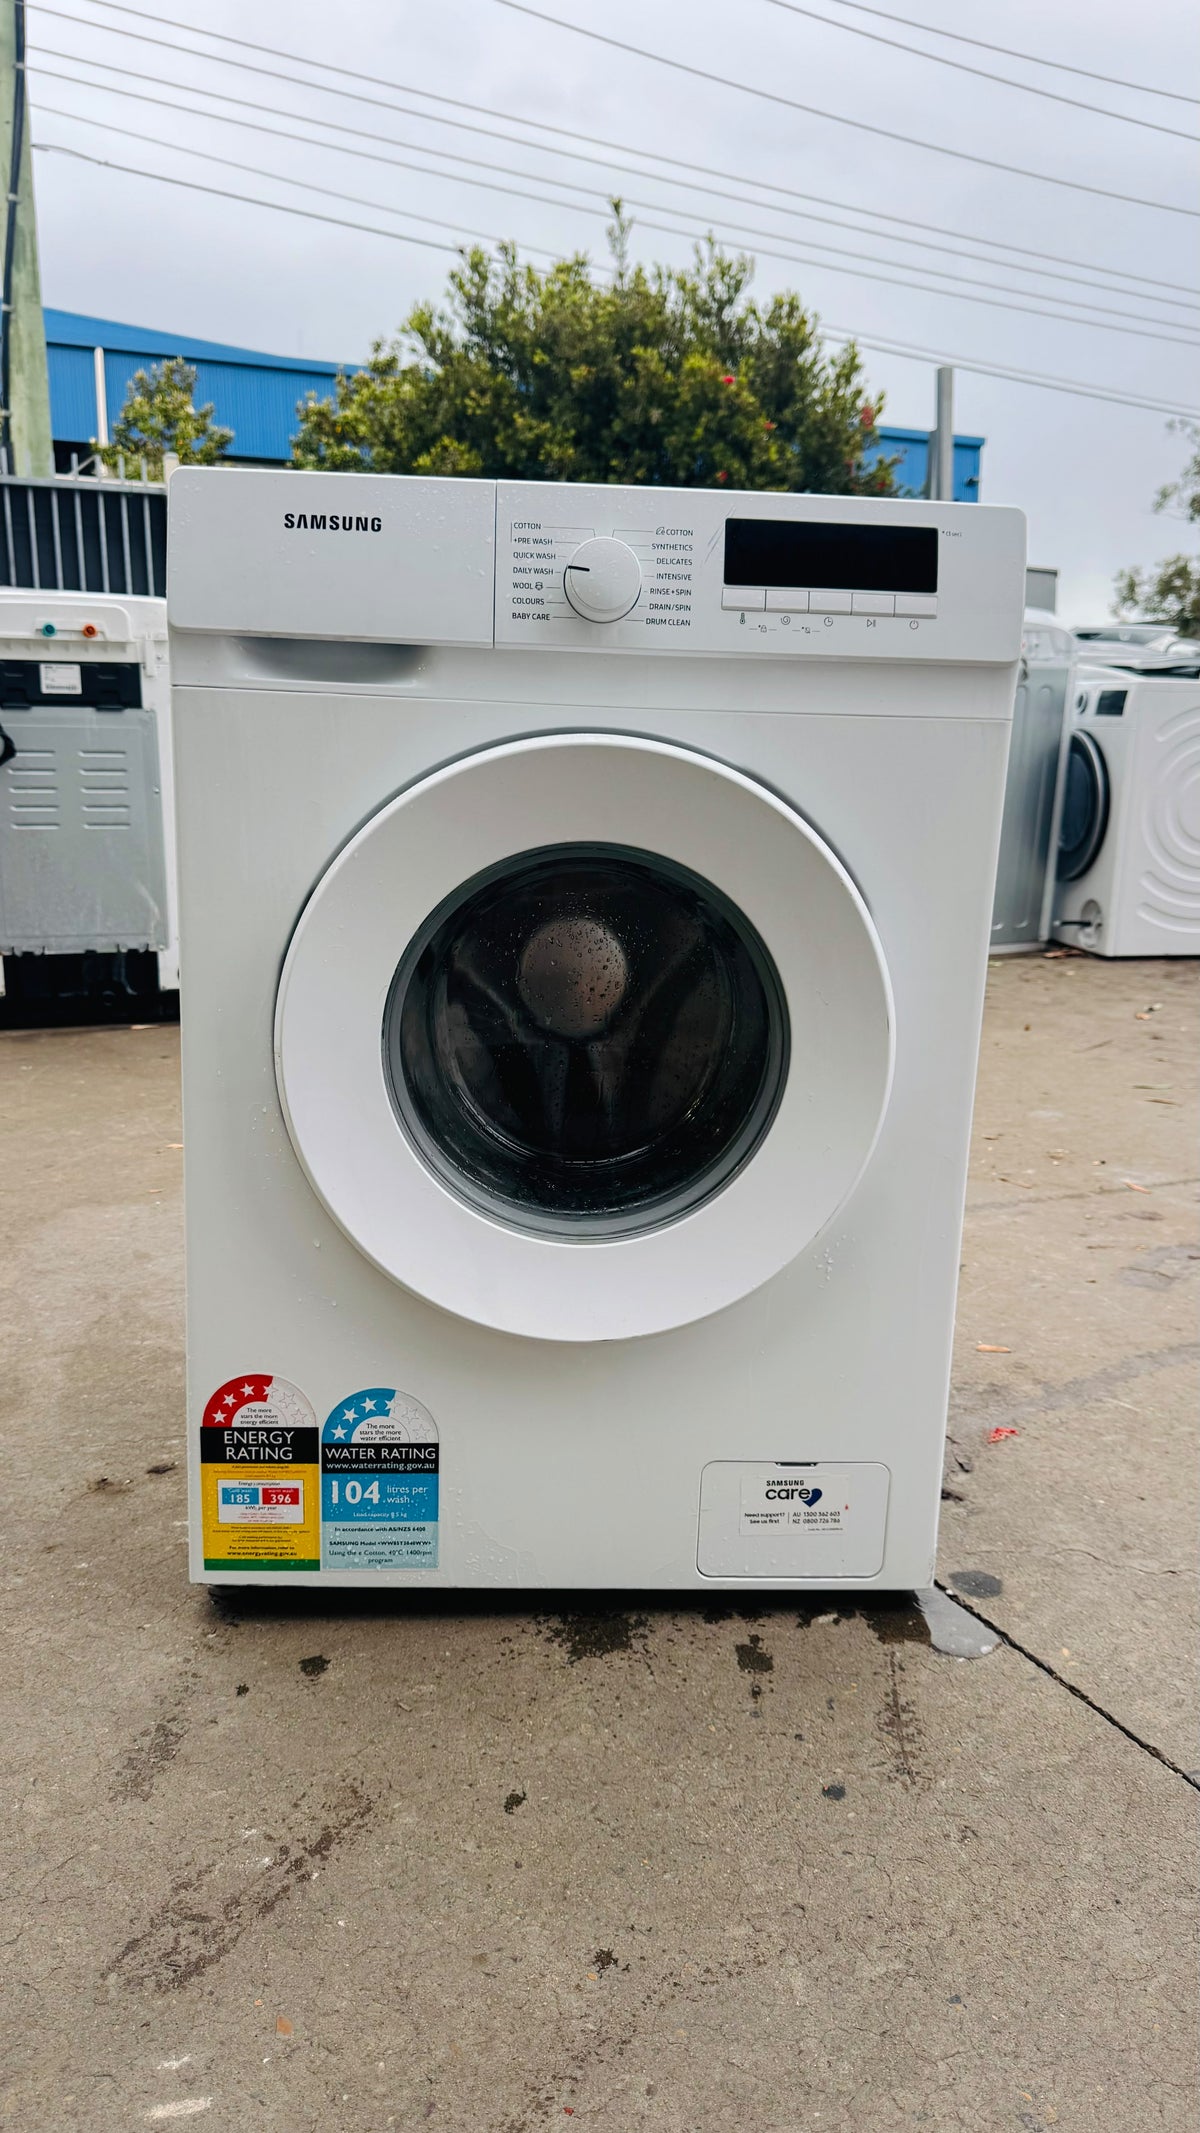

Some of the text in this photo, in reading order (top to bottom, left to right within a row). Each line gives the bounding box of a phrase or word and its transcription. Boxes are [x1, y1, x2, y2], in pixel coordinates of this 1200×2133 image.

[284, 513, 382, 532] SAMSUNG
[652, 543, 693, 552] SYNTHETICS
[512, 597, 544, 605] COLOURS
[224, 1431, 294, 1444] ENERGY
[226, 1447, 292, 1460] RATING
[326, 1448, 436, 1459] WATER RATING
[326, 1462, 434, 1470] www.waterrating.gov.au
[332, 1480, 380, 1504] 104
[387, 1486, 428, 1496] litres per
[766, 1488, 810, 1500] care
[230, 1494, 250, 1503] 185
[270, 1494, 292, 1504] 396
[387, 1496, 410, 1504] wash
